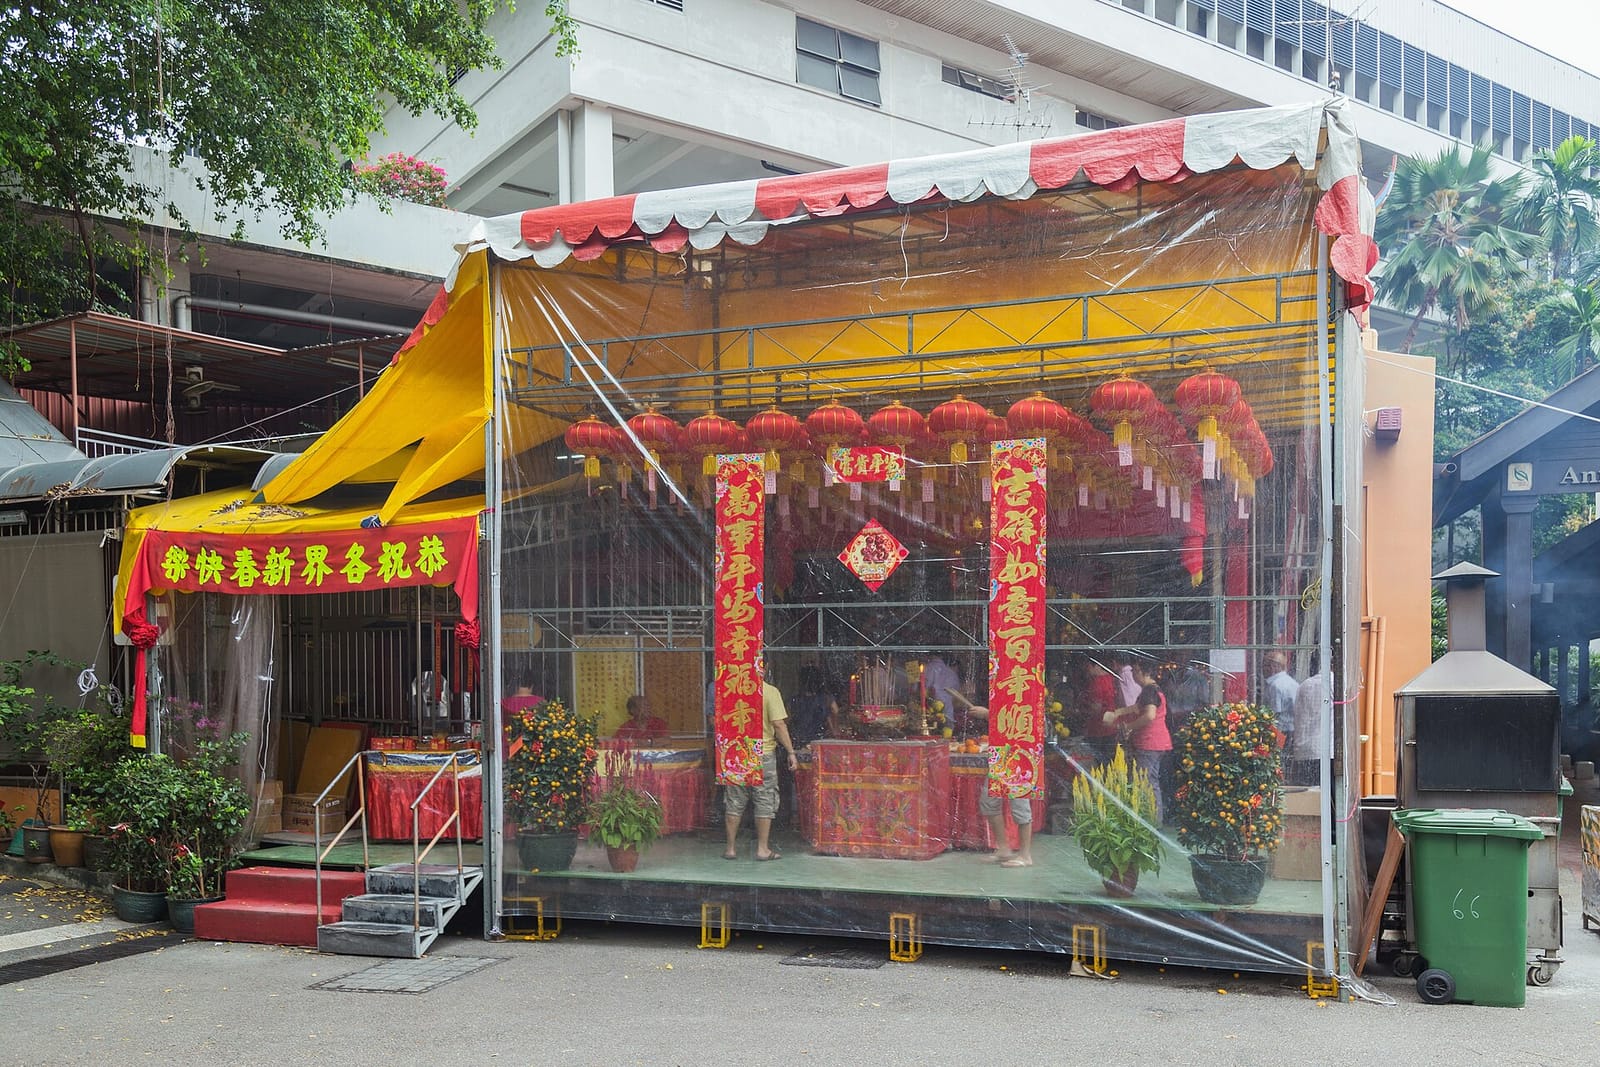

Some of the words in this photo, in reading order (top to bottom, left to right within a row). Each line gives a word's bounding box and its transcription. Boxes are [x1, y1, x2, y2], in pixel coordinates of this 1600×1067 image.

[1559, 466, 1600, 483] An
[997, 467, 1038, 743] 吉祥如意百年順
